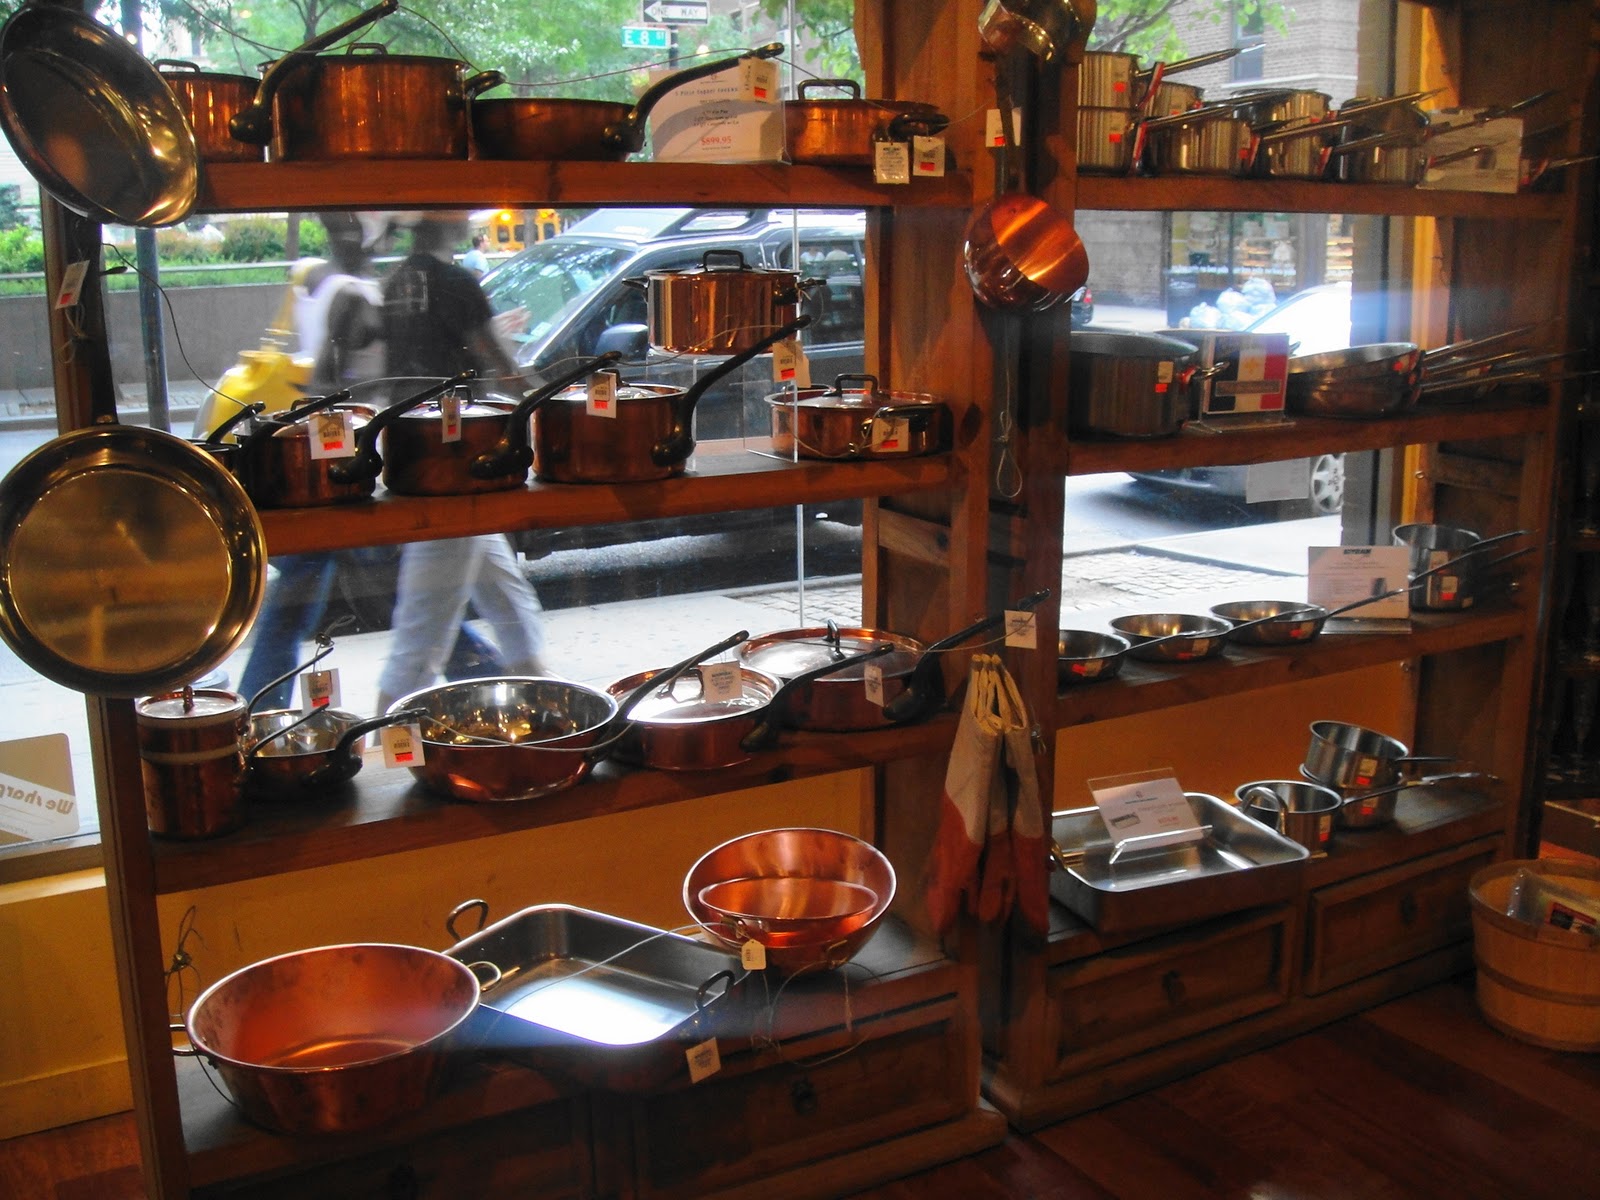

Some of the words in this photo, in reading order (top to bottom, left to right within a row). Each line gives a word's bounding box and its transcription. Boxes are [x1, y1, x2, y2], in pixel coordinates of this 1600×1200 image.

[651, 7, 668, 16] ONE
[681, 8, 698, 16] WAY
[624, 30, 633, 44] E
[640, 30, 649, 45] 8
[701, 136, 731, 145] $899.95
